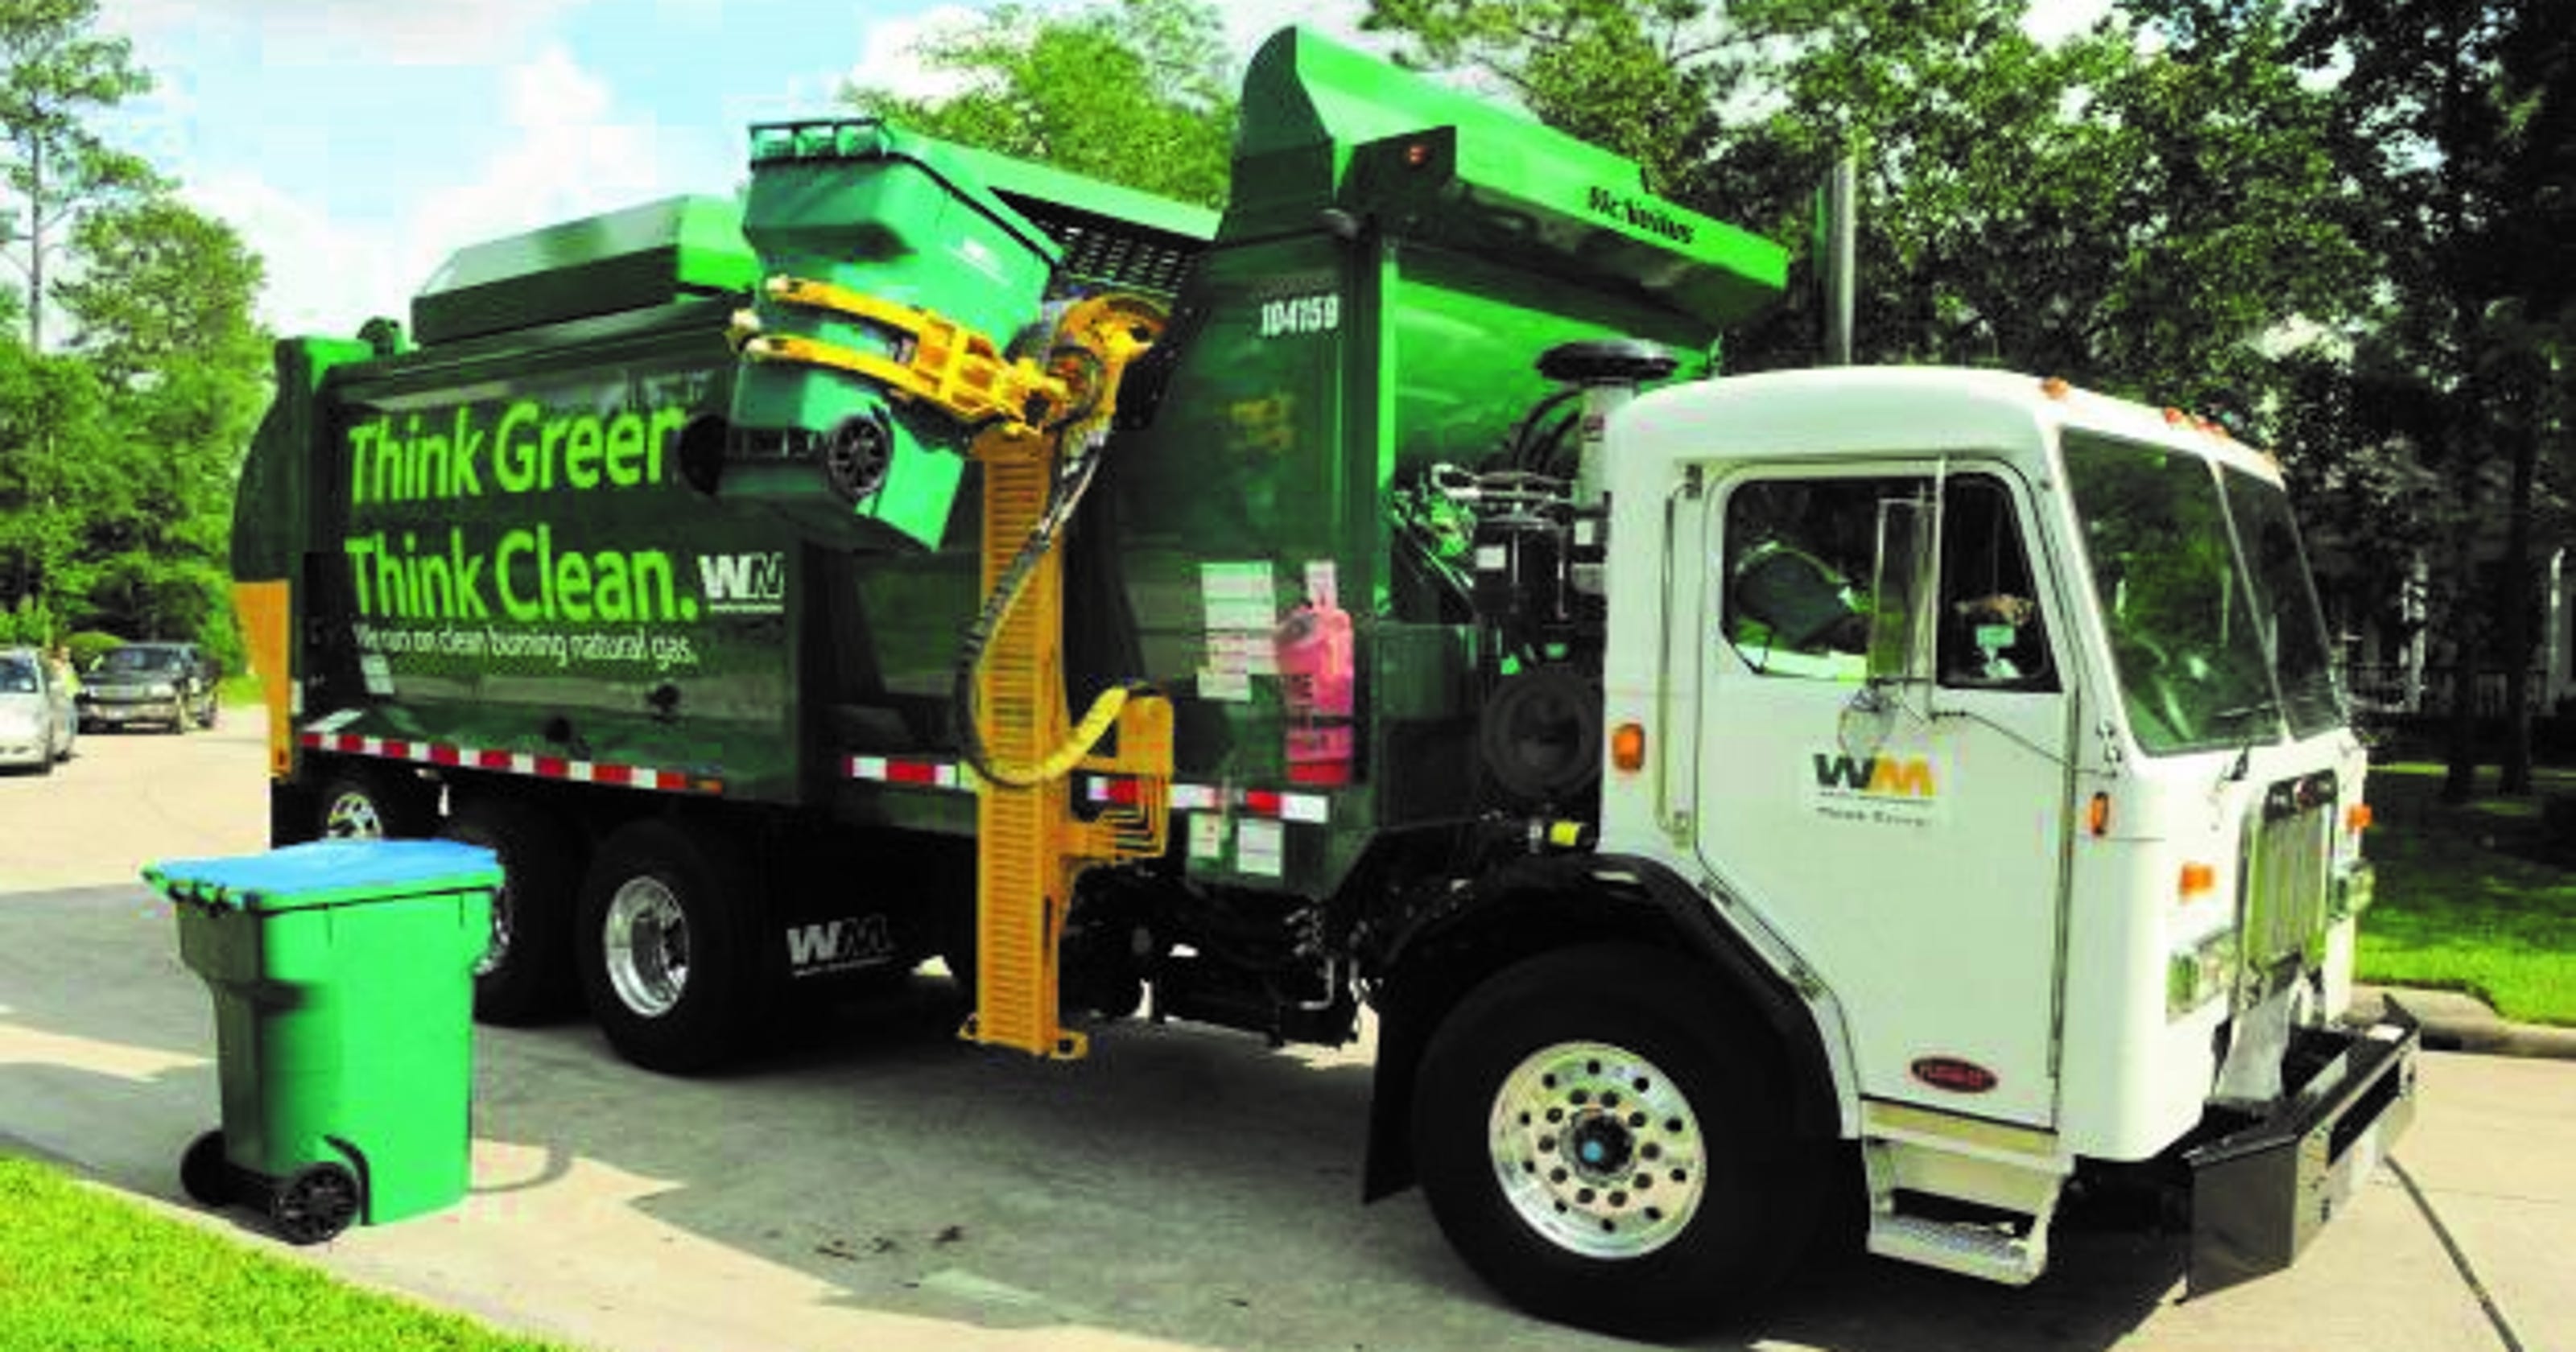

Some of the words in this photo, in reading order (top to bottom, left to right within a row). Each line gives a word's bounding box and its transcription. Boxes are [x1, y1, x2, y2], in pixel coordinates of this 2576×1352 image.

[349, 405, 482, 504] Think
[345, 526, 489, 619] Think
[495, 522, 699, 622] Clean.
[486, 624, 565, 667] burning
[1813, 752, 1937, 797] WM
